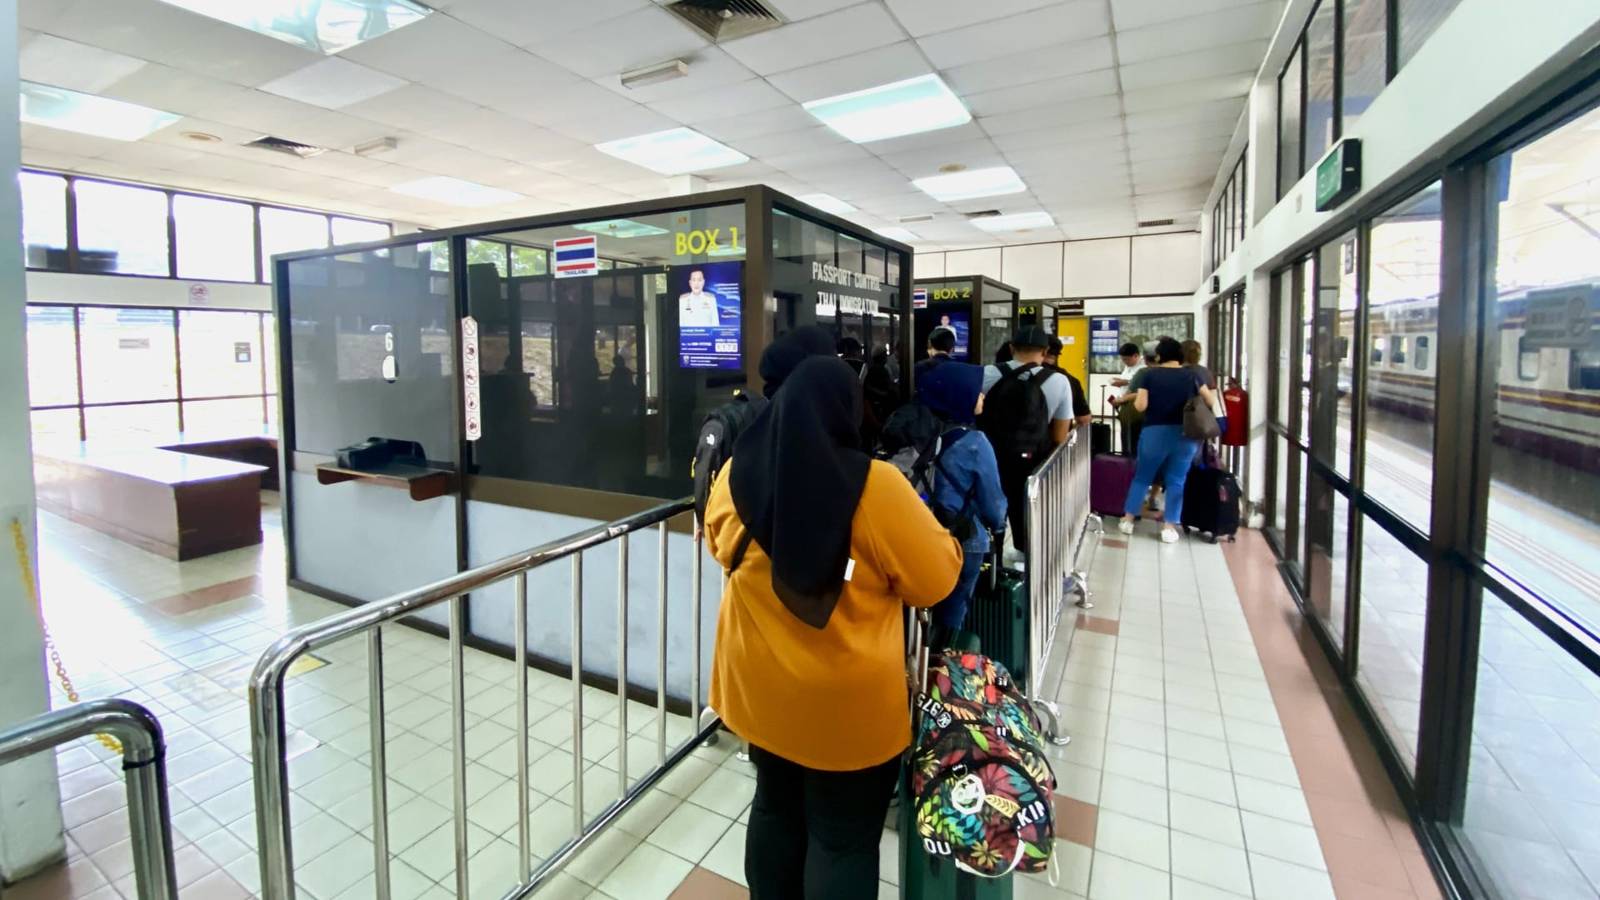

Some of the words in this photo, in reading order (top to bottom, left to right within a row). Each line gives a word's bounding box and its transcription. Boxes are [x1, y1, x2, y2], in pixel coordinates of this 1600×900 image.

[675, 228, 720, 256] BOX
[729, 227, 739, 252] 1
[812, 261, 852, 287] PASSPORT
[817, 291, 837, 307] THAI
[839, 294, 880, 315] IMMIGRATION
[933, 288, 959, 301] BOX
[962, 287, 971, 299] 2
[1028, 306, 1035, 315] 3
[385, 332, 393, 352] 6
